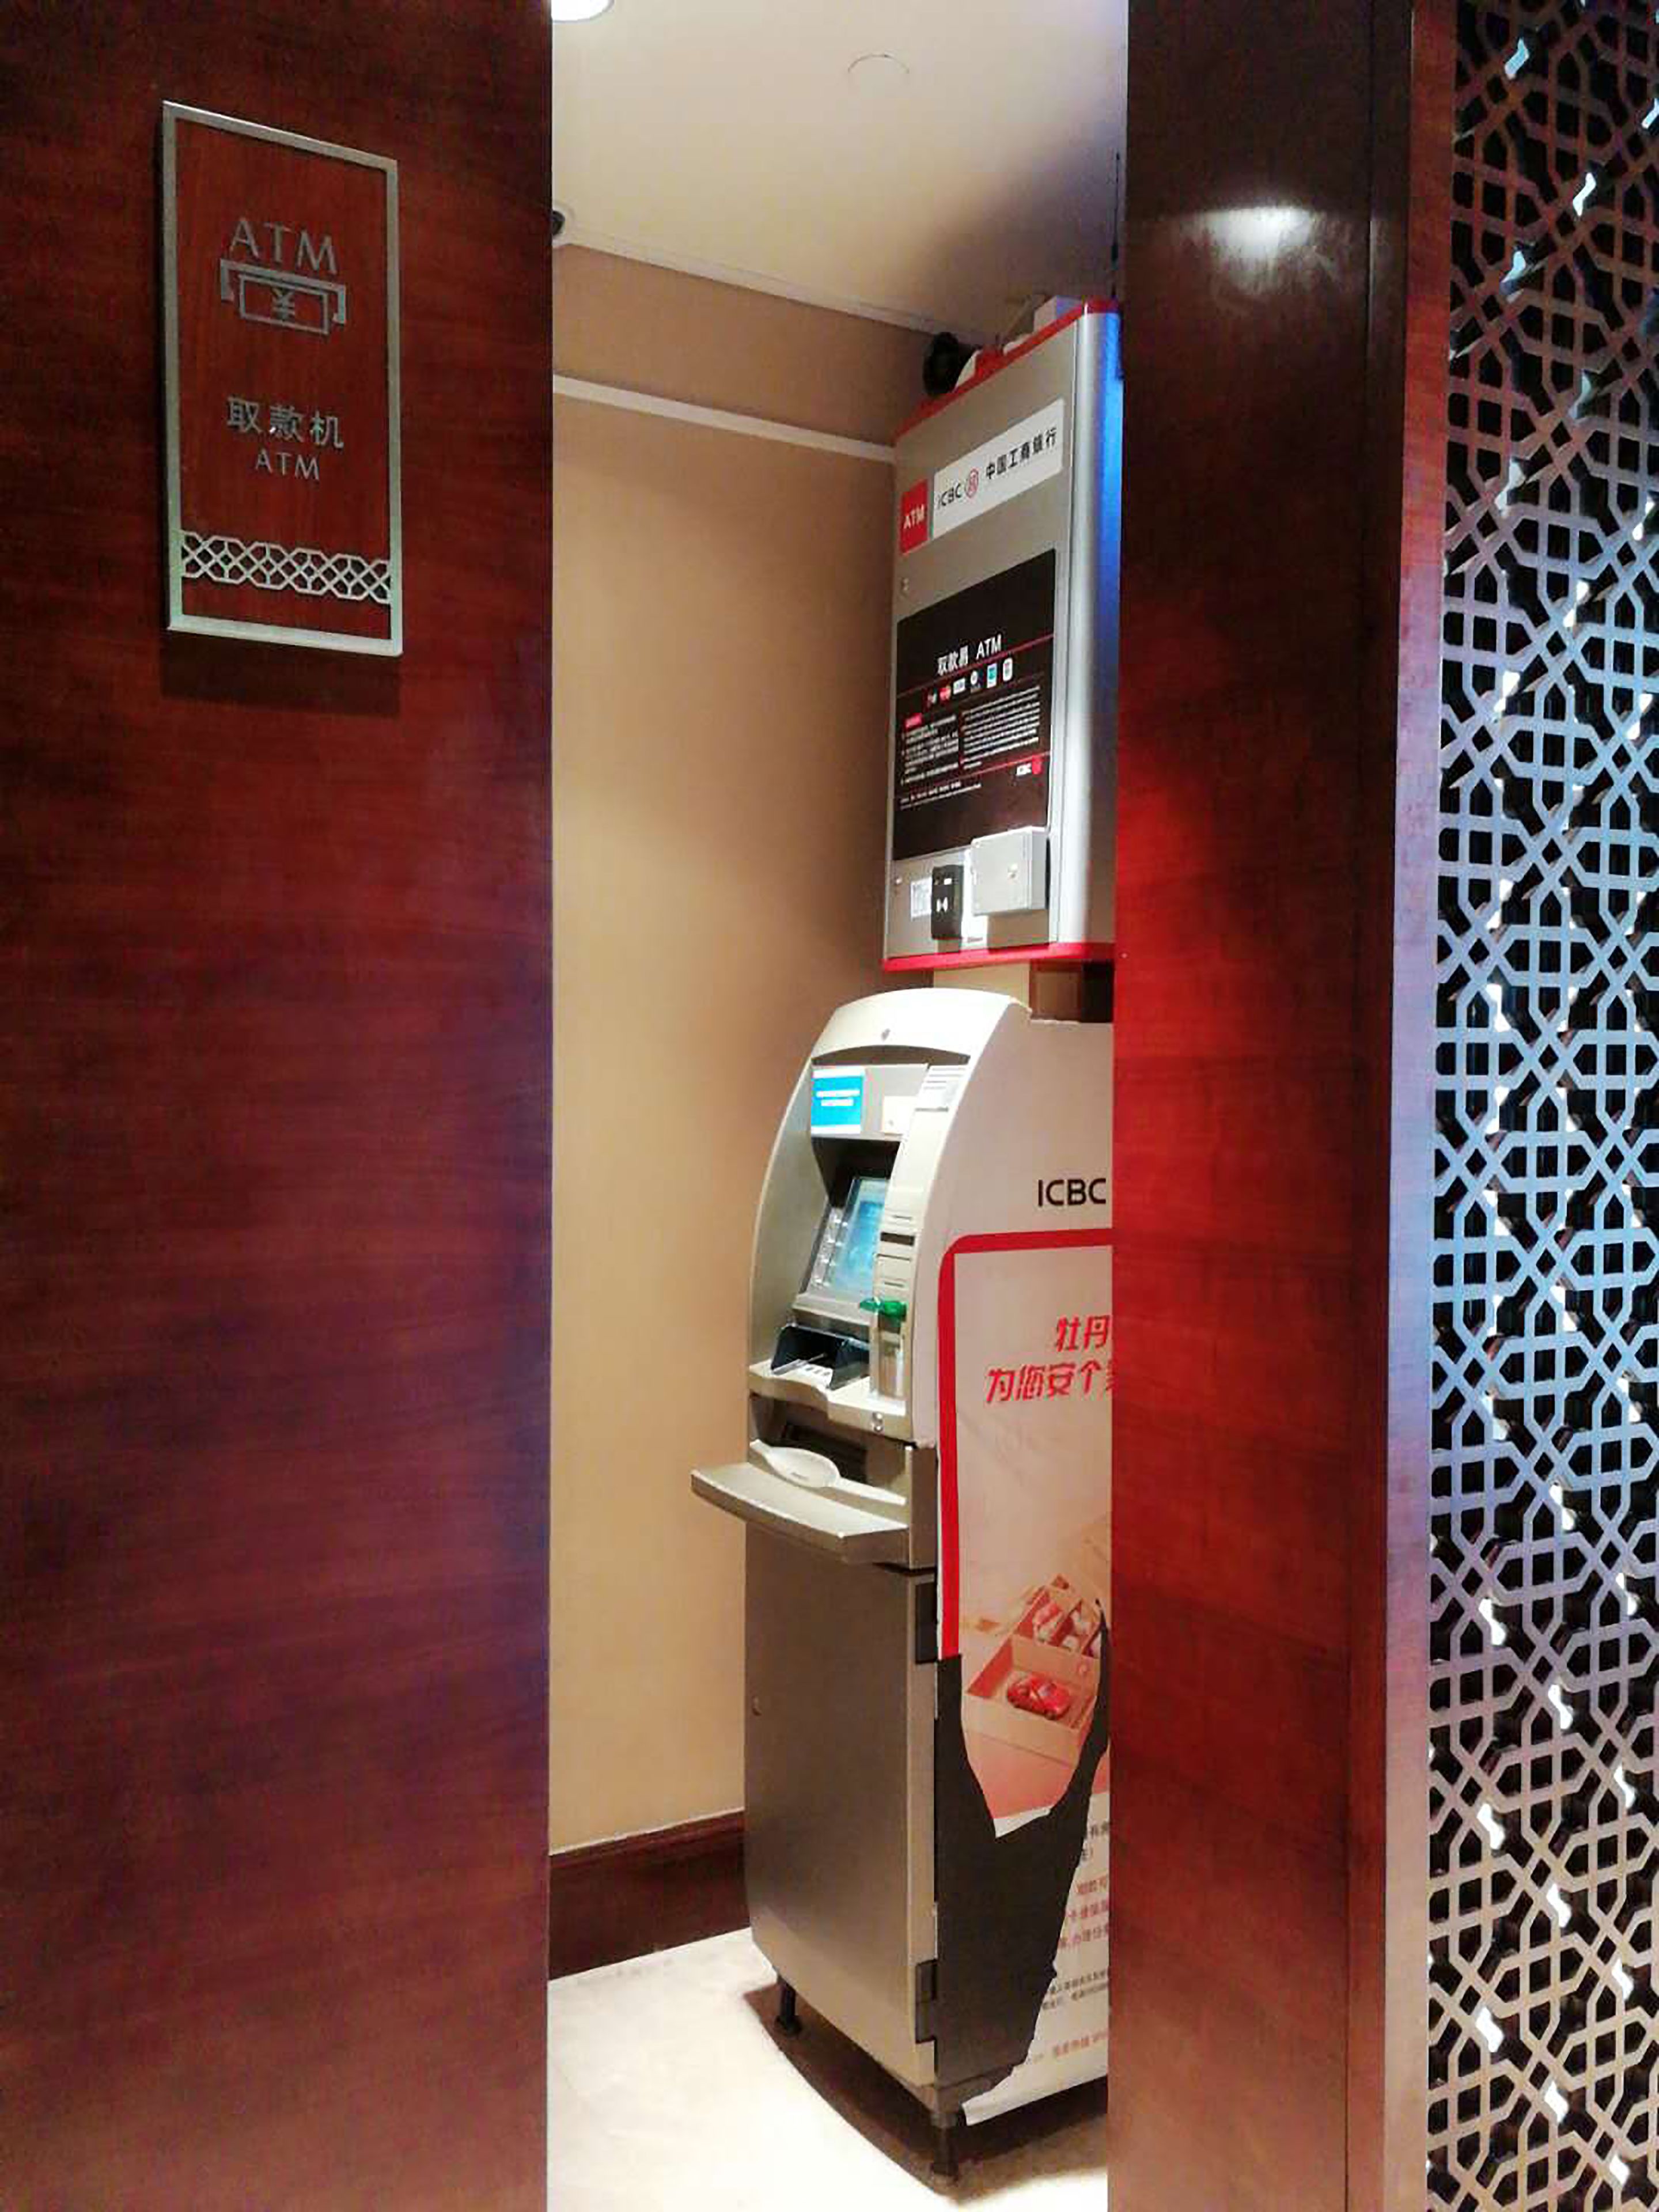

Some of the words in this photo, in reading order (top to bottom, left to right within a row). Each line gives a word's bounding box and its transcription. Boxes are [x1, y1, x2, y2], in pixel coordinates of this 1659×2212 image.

[229, 217, 338, 275] ATM
[227, 395, 344, 449] 取款机
[255, 448, 320, 481] ATM
[936, 483, 963, 510] ICBC
[986, 428, 1056, 479] 中国工商银行
[903, 505, 926, 529] ATM
[976, 634, 1002, 660] ATM
[1038, 1178, 1107, 1207] ICBC
[1055, 1315, 1111, 1353] 牡丹
[986, 1359, 1112, 1403] 为您安个
